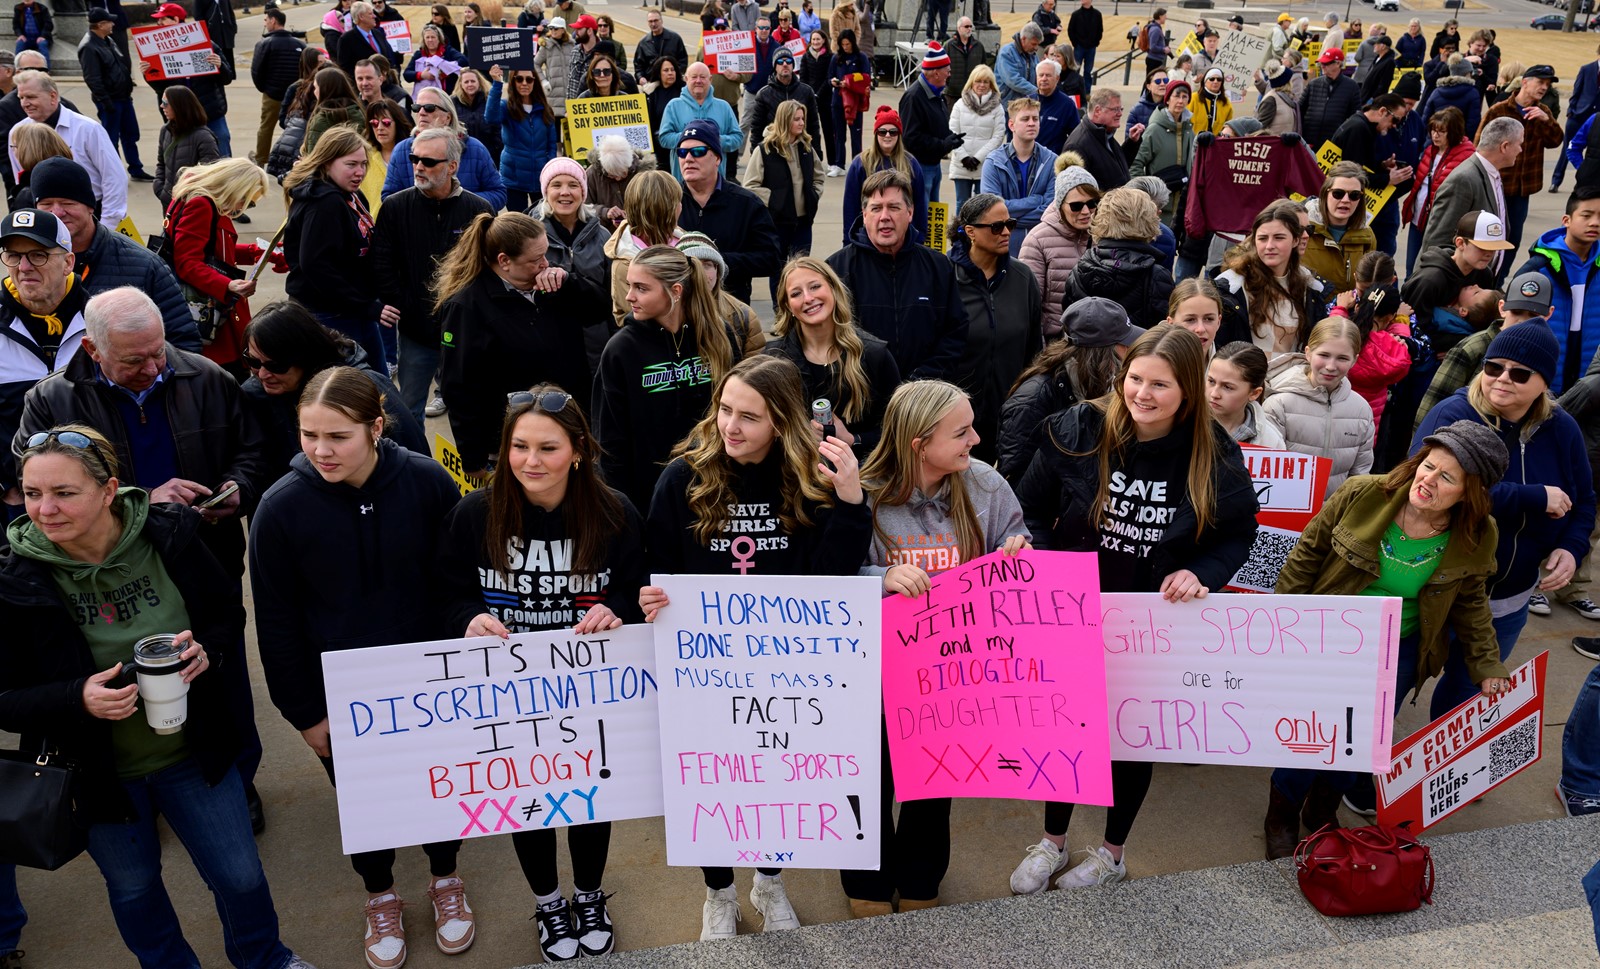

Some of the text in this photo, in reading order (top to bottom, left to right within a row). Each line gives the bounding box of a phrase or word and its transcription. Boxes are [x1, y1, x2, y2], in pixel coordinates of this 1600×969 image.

[137, 23, 198, 46] MY COMPLAINT
[157, 39, 179, 50] FILED
[482, 32, 519, 43] SAVE GIRLS' SPORTS
[505, 42, 520, 50] SPORTS
[716, 32, 749, 44] COMPLAINT
[1228, 32, 1265, 50] MAKE
[1222, 42, 1246, 55] ALL
[572, 100, 642, 115] SEE SOMETHING.
[574, 113, 645, 128] SAY SOMETHING.
[1234, 142, 1271, 159] SCSU
[1322, 149, 1340, 164] SEE
[1228, 159, 1271, 172] WOMEN'S
[1233, 173, 1262, 185] TRACK
[935, 208, 944, 222] SEE
[444, 449, 464, 480] SEE
[1108, 471, 1167, 502] SAVE
[727, 503, 770, 516] SAVE
[718, 518, 780, 532] GIRLS'
[959, 558, 1034, 594] STAND
[70, 575, 151, 605] SAVE WOMEN'S
[504, 608, 573, 625] COMMON
[701, 591, 862, 626] HORMONES,
[897, 601, 976, 647] WITH
[1200, 606, 1364, 655] SPORTS
[677, 630, 866, 659] BONE DENSITY,
[940, 634, 1014, 658] and my
[424, 639, 610, 682] IT'S NOT
[675, 667, 847, 689] MUSCLE MASS.
[917, 658, 1055, 695] BIOLOGICAL
[1182, 670, 1244, 690] are for
[349, 666, 658, 736] DISCRIMINATION
[732, 696, 823, 725] FACTS
[898, 693, 1086, 740] DAUGHTER.
[1116, 698, 1251, 755] GIRLS
[473, 716, 577, 755] IT'S
[756, 731, 789, 749] IN
[1424, 726, 1474, 772] FILED
[678, 752, 859, 785] FEMALE SPORTS
[1385, 752, 1413, 784] MY
[1430, 768, 1454, 792] FILE
[1430, 773, 1468, 804] YOURS
[1430, 791, 1461, 818] HERE
